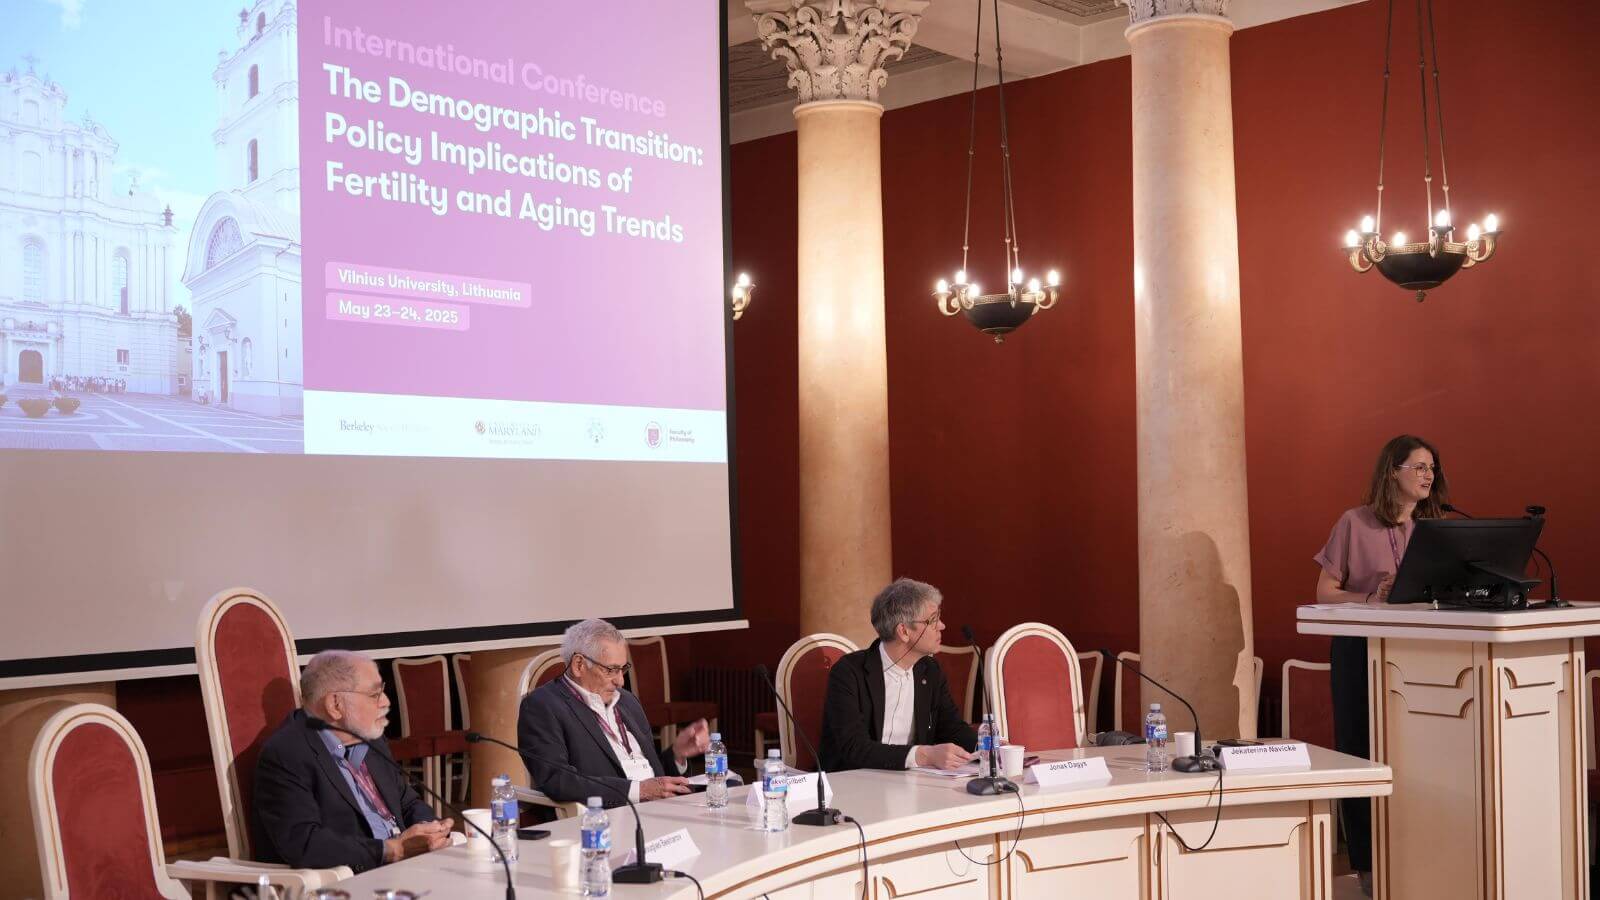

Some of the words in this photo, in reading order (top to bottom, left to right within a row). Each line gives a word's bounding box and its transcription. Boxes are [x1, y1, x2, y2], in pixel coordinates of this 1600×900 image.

[323, 16, 514, 86] International
[521, 63, 667, 118] Conference
[322, 63, 382, 103] The
[389, 77, 577, 141] Demographic
[581, 117, 704, 167] Transition:
[326, 112, 422, 165] Policy
[431, 131, 600, 189] Implications
[607, 167, 634, 194] of
[326, 161, 448, 216] Fertility
[456, 189, 512, 218] and
[519, 192, 596, 237] Aging
[601, 205, 684, 243] Trends
[338, 268, 385, 287] Vilnius
[388, 273, 459, 297] University,
[463, 283, 521, 301] Lithuania
[339, 300, 370, 318] May
[425, 308, 459, 324] 2025
[340, 418, 375, 436] Berkeley
[1049, 763, 1067, 771] Jonas
